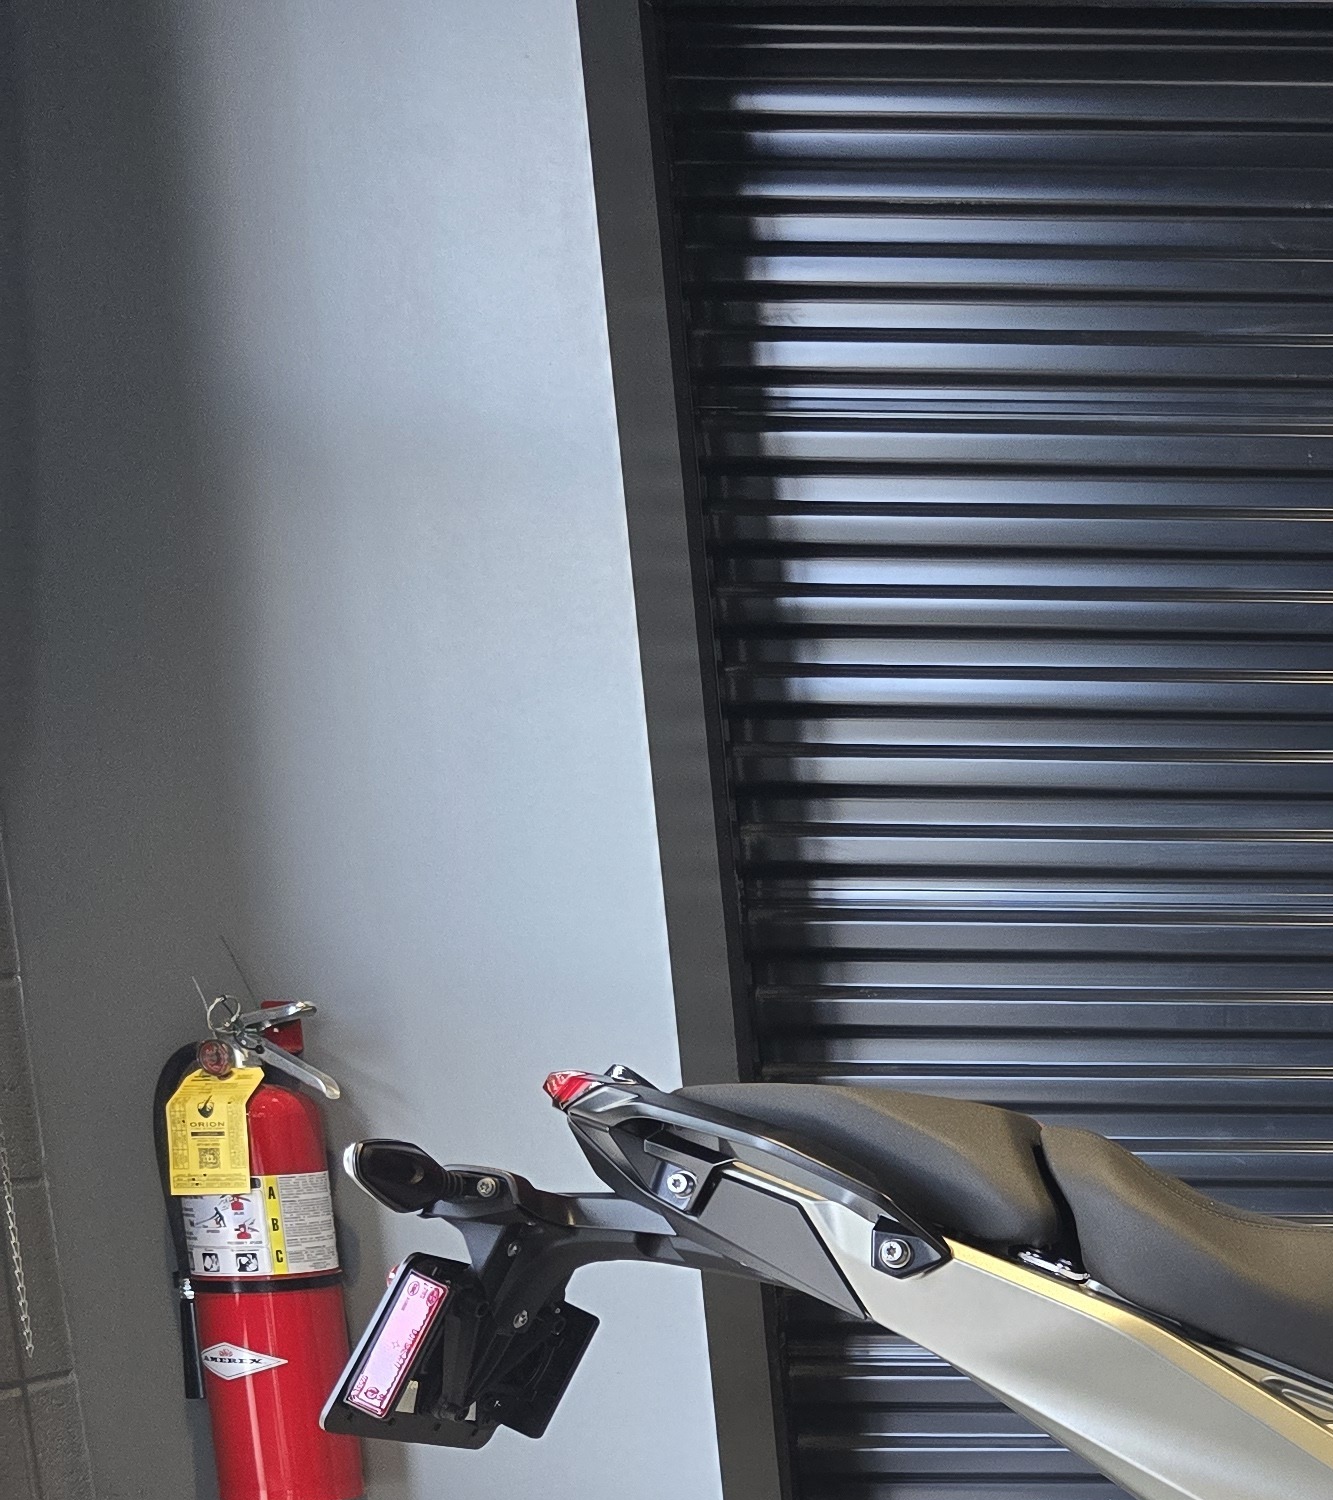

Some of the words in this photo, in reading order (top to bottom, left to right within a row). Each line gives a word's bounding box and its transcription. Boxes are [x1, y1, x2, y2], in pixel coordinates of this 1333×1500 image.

[267, 1186, 276, 1200] A
[271, 1217, 280, 1232] B
[275, 1249, 284, 1263] C
[203, 1355, 263, 1365] AMEREX
